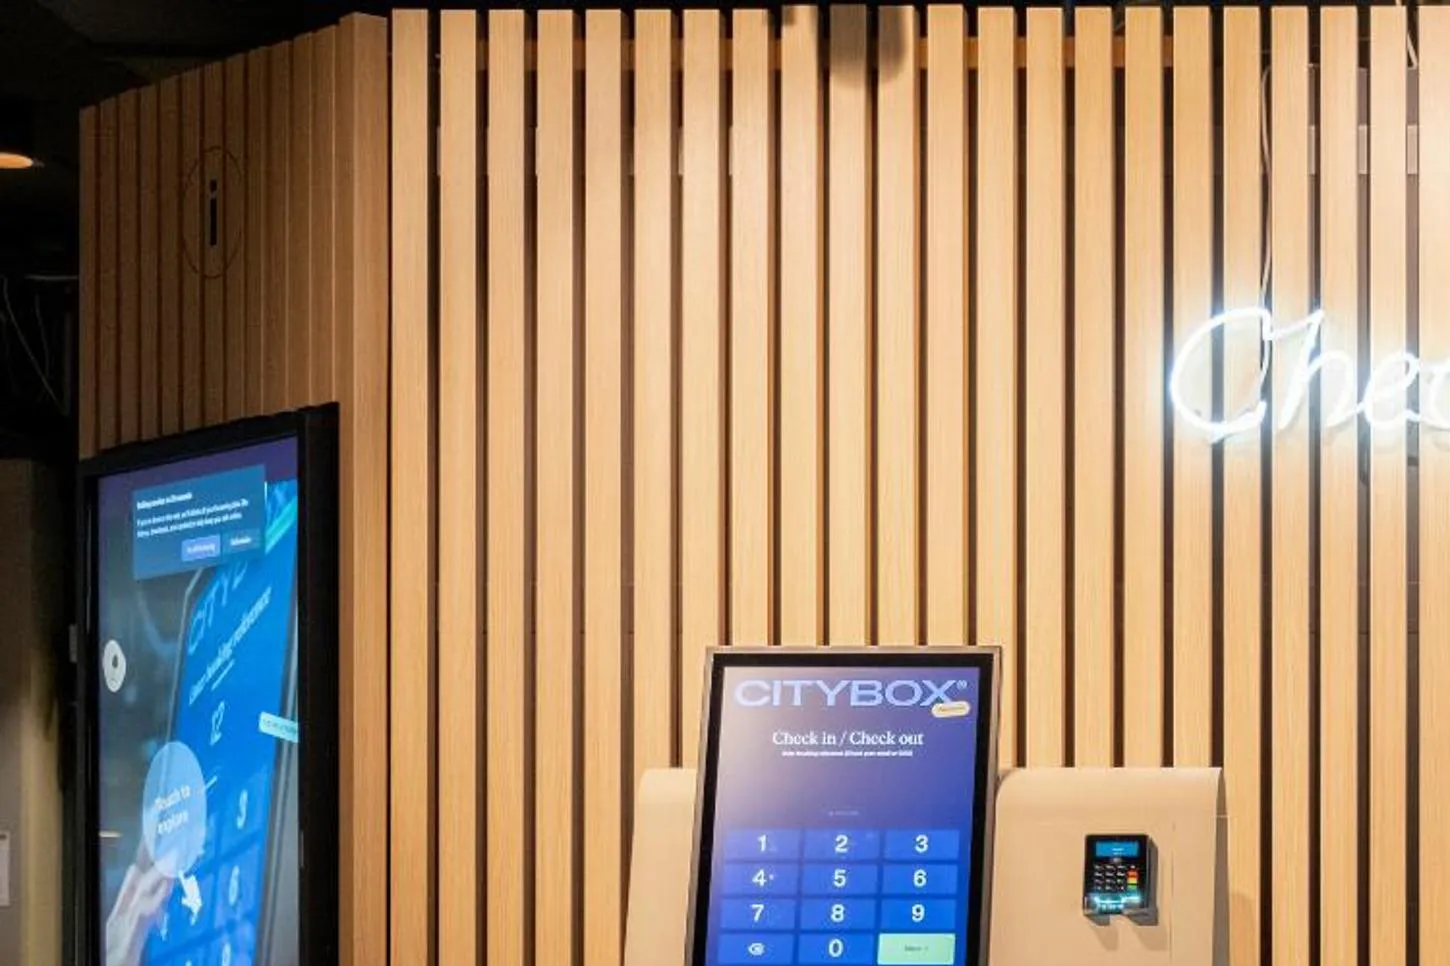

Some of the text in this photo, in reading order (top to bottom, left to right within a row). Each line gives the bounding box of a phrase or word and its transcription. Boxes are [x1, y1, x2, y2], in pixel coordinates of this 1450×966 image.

[772, 730, 818, 746] Check
[821, 730, 836, 746] in
[849, 730, 895, 746] Check
[899, 732, 924, 746] out
[757, 835, 928, 852] 1 2 3
[752, 869, 926, 887] 4 5 6
[751, 904, 925, 921] 7 8 9
[829, 939, 843, 957] 0
